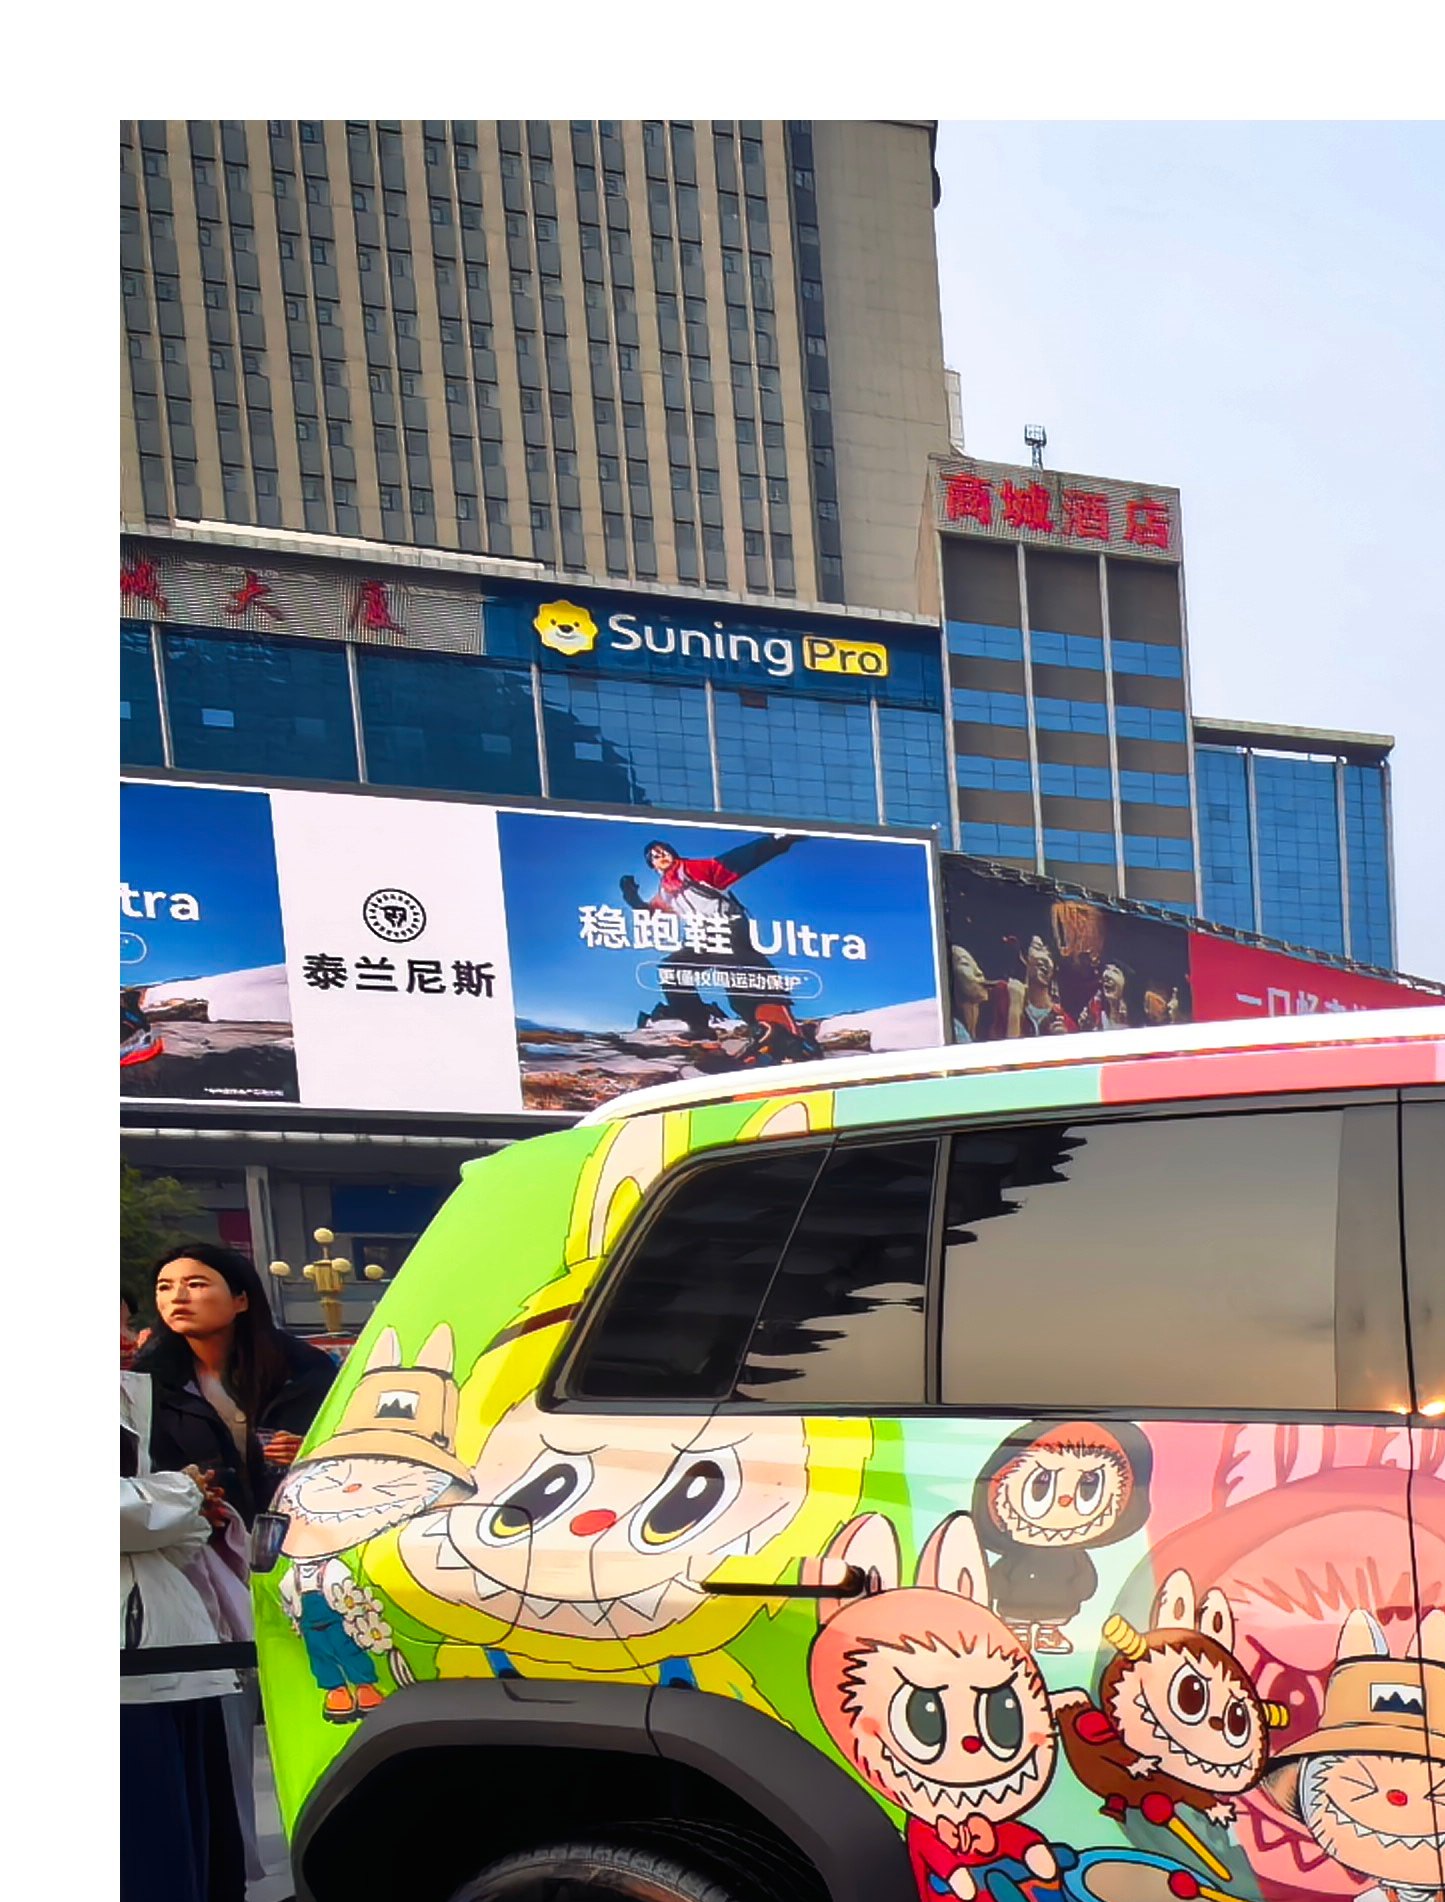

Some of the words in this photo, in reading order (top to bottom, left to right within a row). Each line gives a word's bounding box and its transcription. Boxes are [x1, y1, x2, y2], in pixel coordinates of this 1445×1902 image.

[940, 472, 1169, 549] 商城酒店
[608, 613, 795, 677] Suning
[807, 638, 883, 674] Pro
[577, 903, 735, 955] 稳跑鞋
[749, 918, 868, 960] Ultra
[301, 952, 496, 998] 泰兰尼斯
